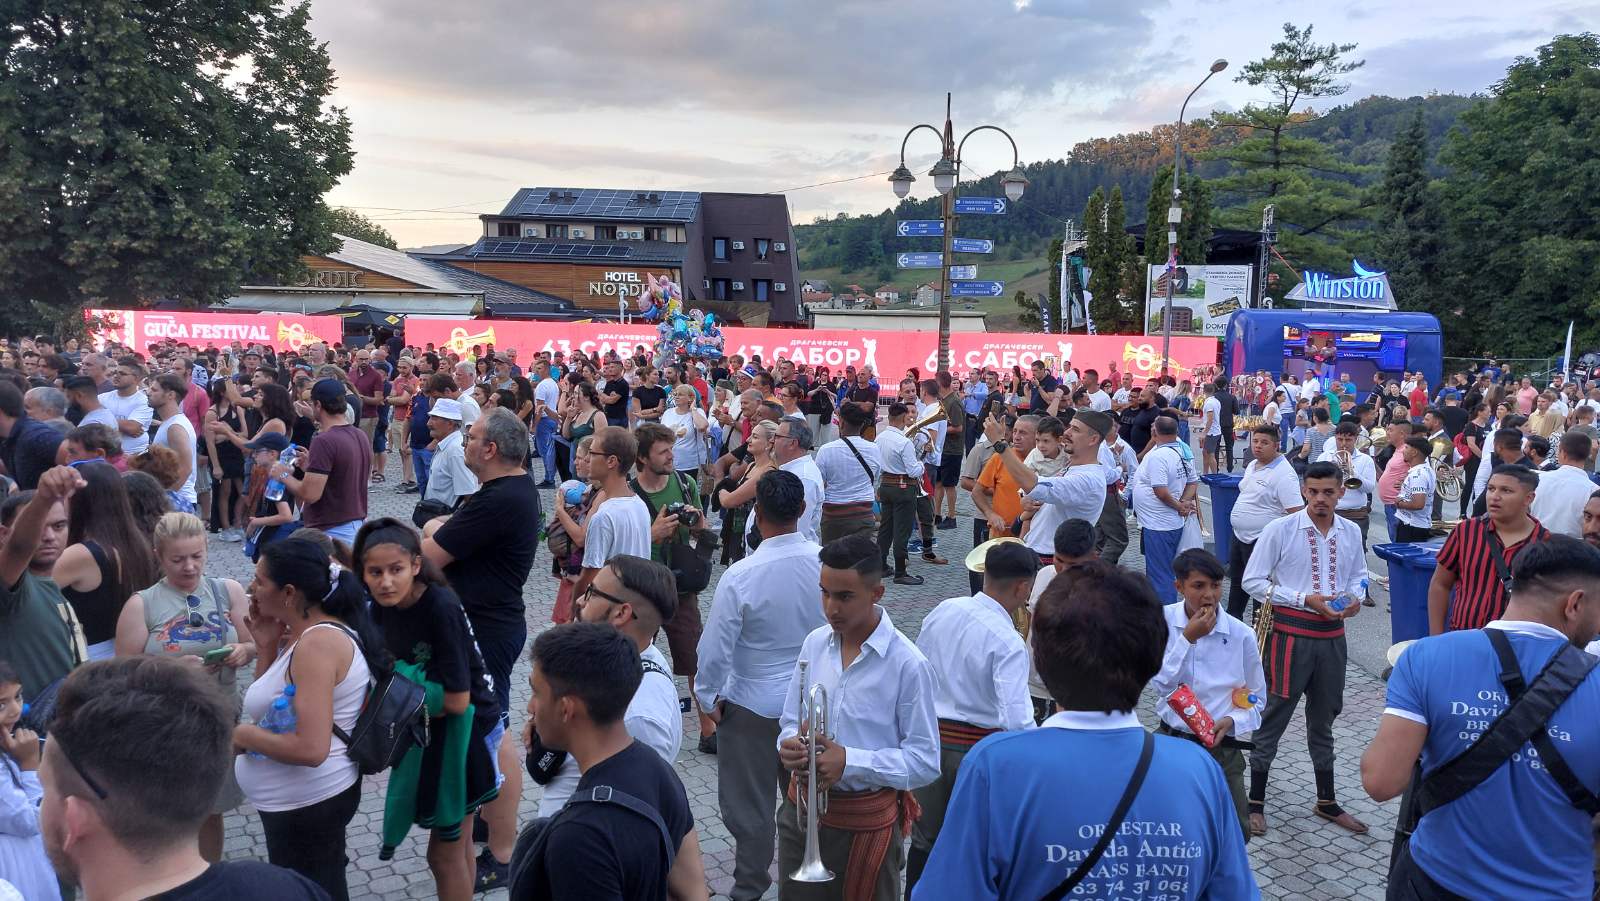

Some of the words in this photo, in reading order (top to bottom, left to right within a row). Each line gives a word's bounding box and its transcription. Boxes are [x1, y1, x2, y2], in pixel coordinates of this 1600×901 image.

[605, 271, 641, 282] HOTEL
[1304, 270, 1384, 299] Winston
[144, 320, 189, 338] GUČA
[191, 323, 270, 341] FESTIVAL
[790, 339, 848, 347] ДРАГАЧЕВСКИ
[983, 343, 1044, 351] ДРАГАЧЕВСКИ
[1078, 821, 1183, 840] ORESTAR
[1044, 838, 1128, 863] Davda
[1136, 839, 1202, 859] Antića
[1136, 863, 1189, 878] BAND
[1105, 880, 1126, 896] 74
[1132, 879, 1151, 895] 31
